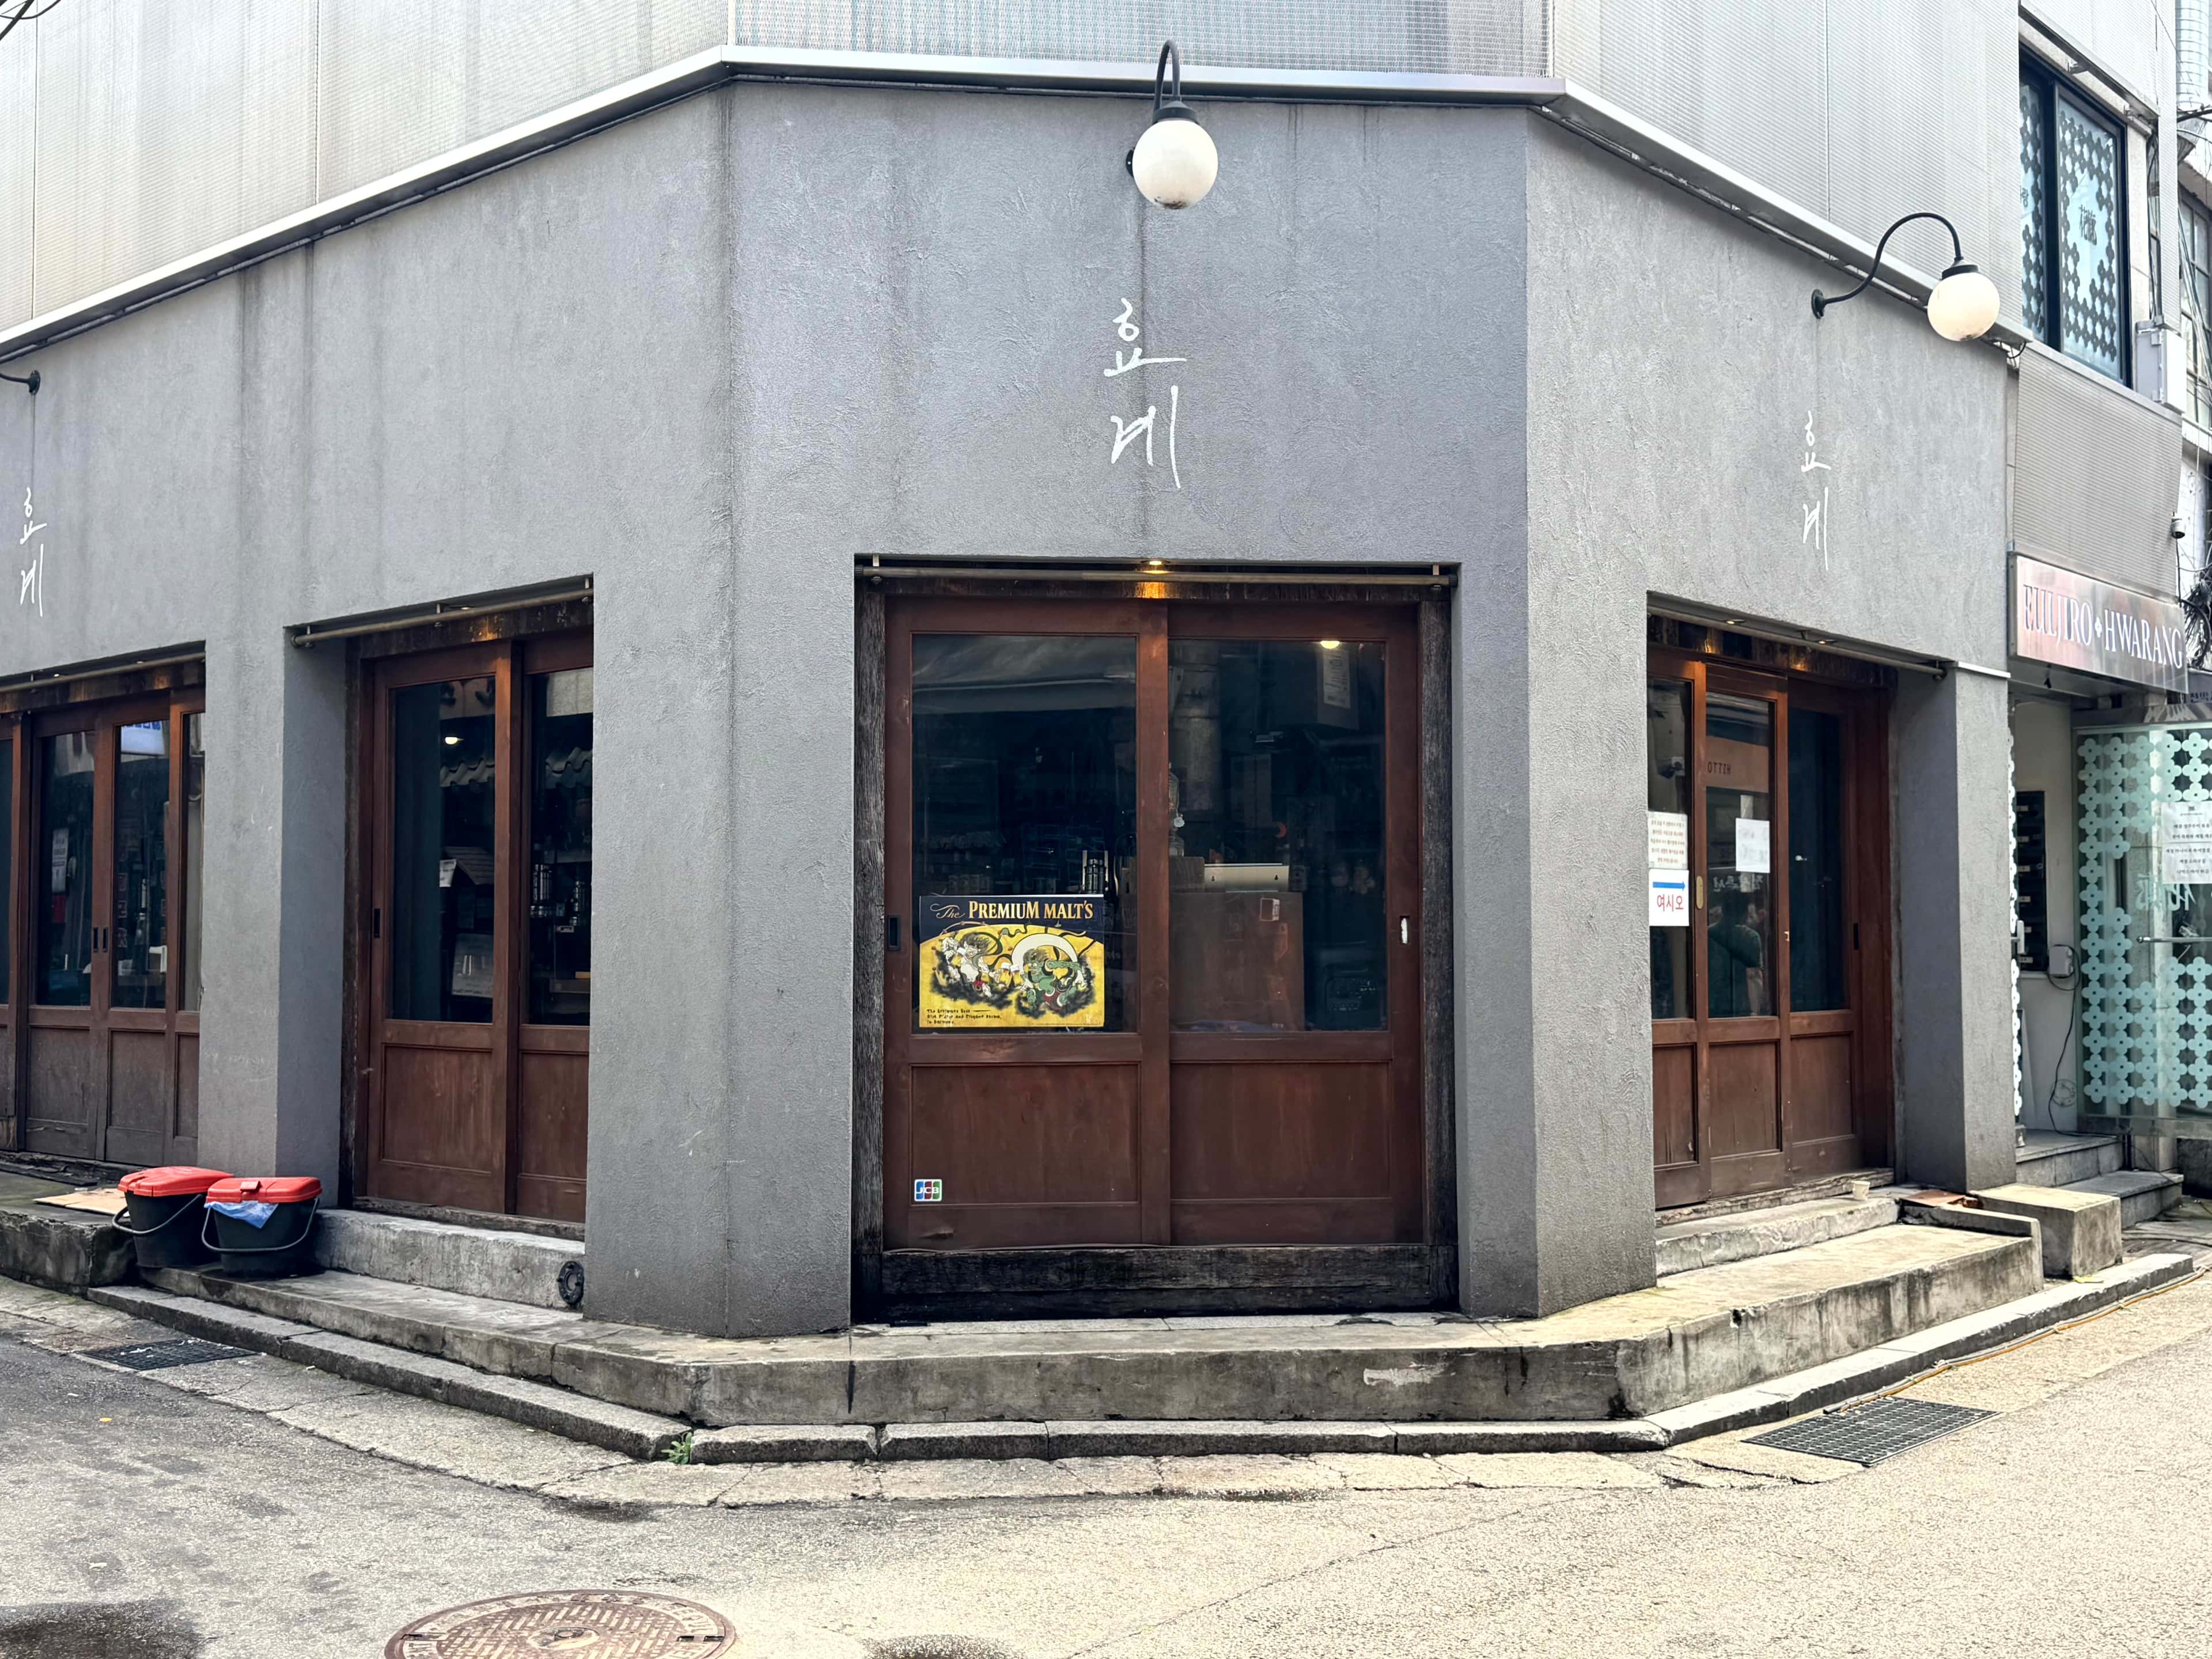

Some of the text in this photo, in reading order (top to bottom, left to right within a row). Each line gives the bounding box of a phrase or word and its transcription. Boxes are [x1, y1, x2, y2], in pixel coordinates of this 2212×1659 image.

[2022, 584, 2183, 669] EULJIRO HWARANG
[930, 900, 1094, 919] The PREMIUM MALT'S
[1657, 893, 1684, 912] 여시오
